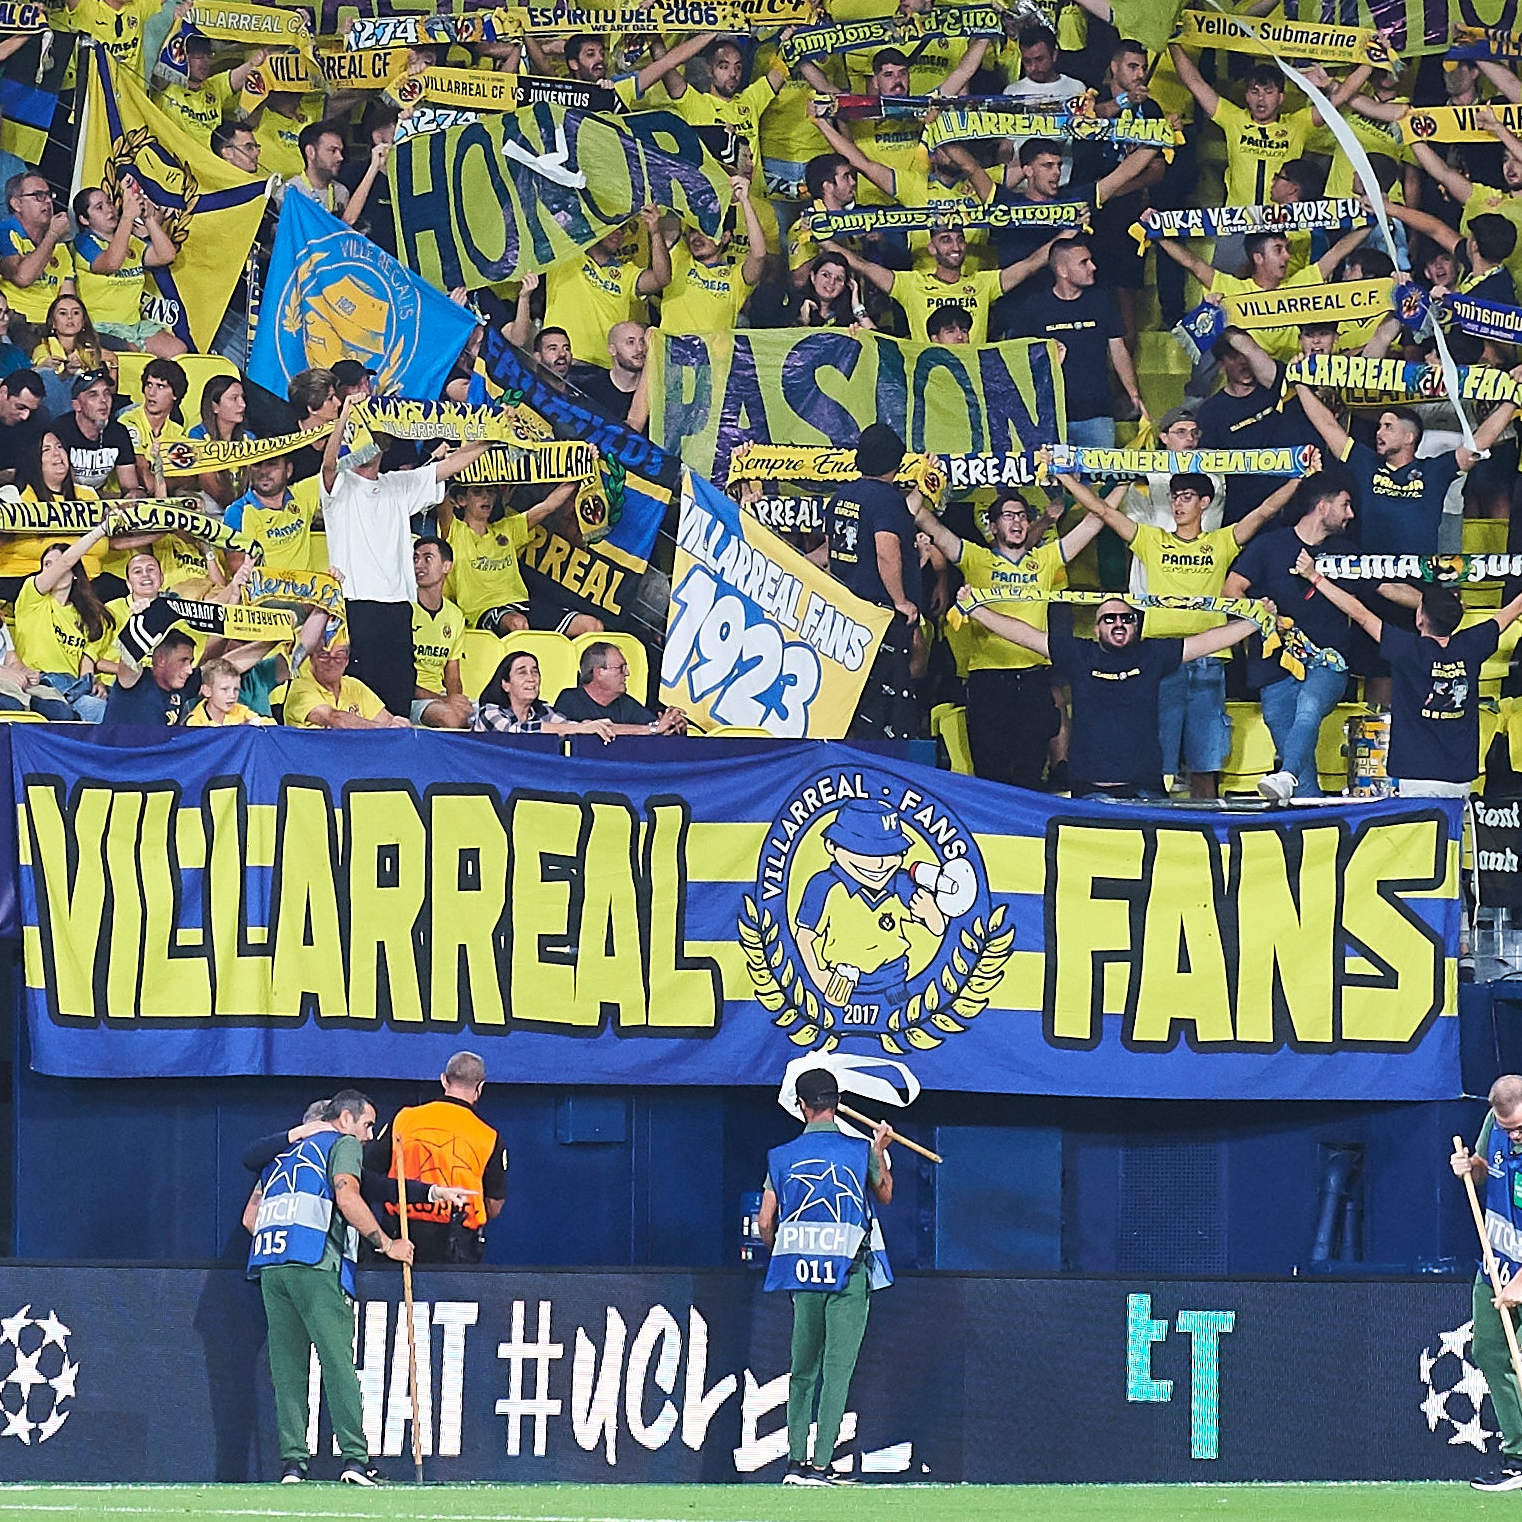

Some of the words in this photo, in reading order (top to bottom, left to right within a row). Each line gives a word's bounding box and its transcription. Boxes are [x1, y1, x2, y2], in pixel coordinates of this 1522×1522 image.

[528, 8, 616, 28] ESPIRITU
[621, 5, 658, 26] DEL
[663, 2, 718, 26] 2006
[1259, 21, 1358, 48] Submarine
[423, 77, 488, 99] VILLARREAL
[491, 82, 506, 100] CF
[510, 84, 524, 102] VS
[527, 87, 590, 106] JUVENTUS
[394, 103, 724, 290] HONOR
[809, 207, 930, 237] Campions
[968, 202, 1079, 229] d'Europa
[1208, 206, 1250, 231] VEZ
[1292, 200, 1331, 228] POR
[1236, 286, 1344, 316] VILLARREAL
[1349, 282, 1382, 308] C.F.
[732, 453, 806, 474] Sempre
[1080, 448, 1158, 472] REINAR
[1198, 449, 1297, 473] VOLVER
[1160, 552, 1214, 568] PAMESA
[678, 497, 803, 630] VILLARREAL
[799, 591, 874, 672] FANS
[660, 565, 823, 738] 1923
[880, 810, 898, 832] VF
[761, 773, 870, 902] VILLARREAL
[898, 787, 968, 861] FANS
[26, 775, 719, 1037] VILLARREAL
[1048, 817, 1446, 1049] FANS
[841, 1004, 879, 1026] 2017
[781, 1225, 849, 1251] PITCH
[794, 1259, 836, 1283] 011
